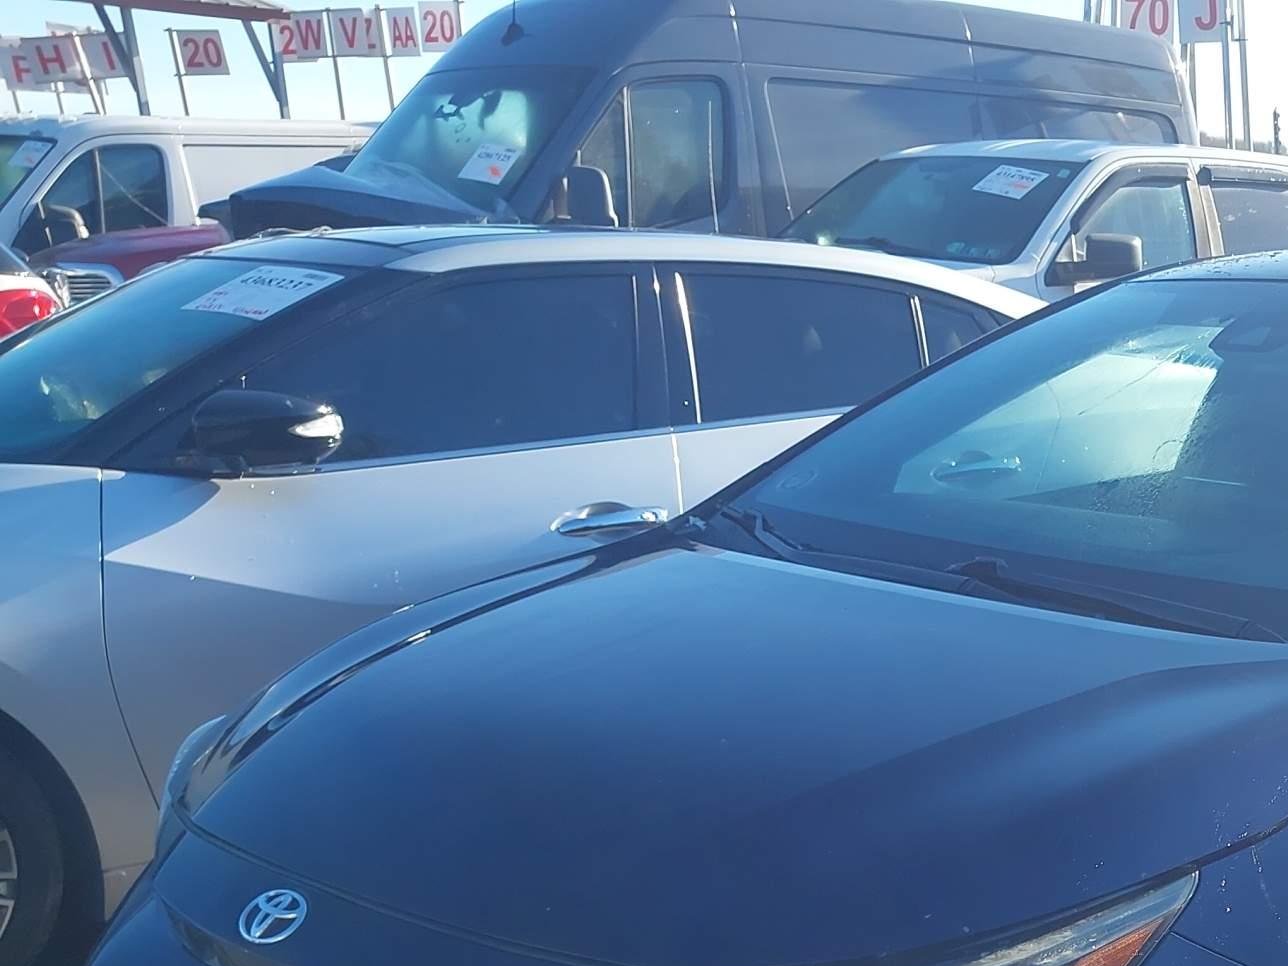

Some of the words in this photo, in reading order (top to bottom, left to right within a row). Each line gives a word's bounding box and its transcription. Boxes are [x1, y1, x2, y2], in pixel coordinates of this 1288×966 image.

[423, 10, 454, 43] 20
[1125, 0, 1169, 35] 70
[1195, 0, 1217, 30] J
[295, 19, 321, 50] W
[339, 17, 357, 48] V
[393, 16, 416, 48] AA
[35, 45, 67, 74] H
[101, 41, 116, 70] I
[183, 38, 222, 67] 20
[12, 56, 31, 83] F
